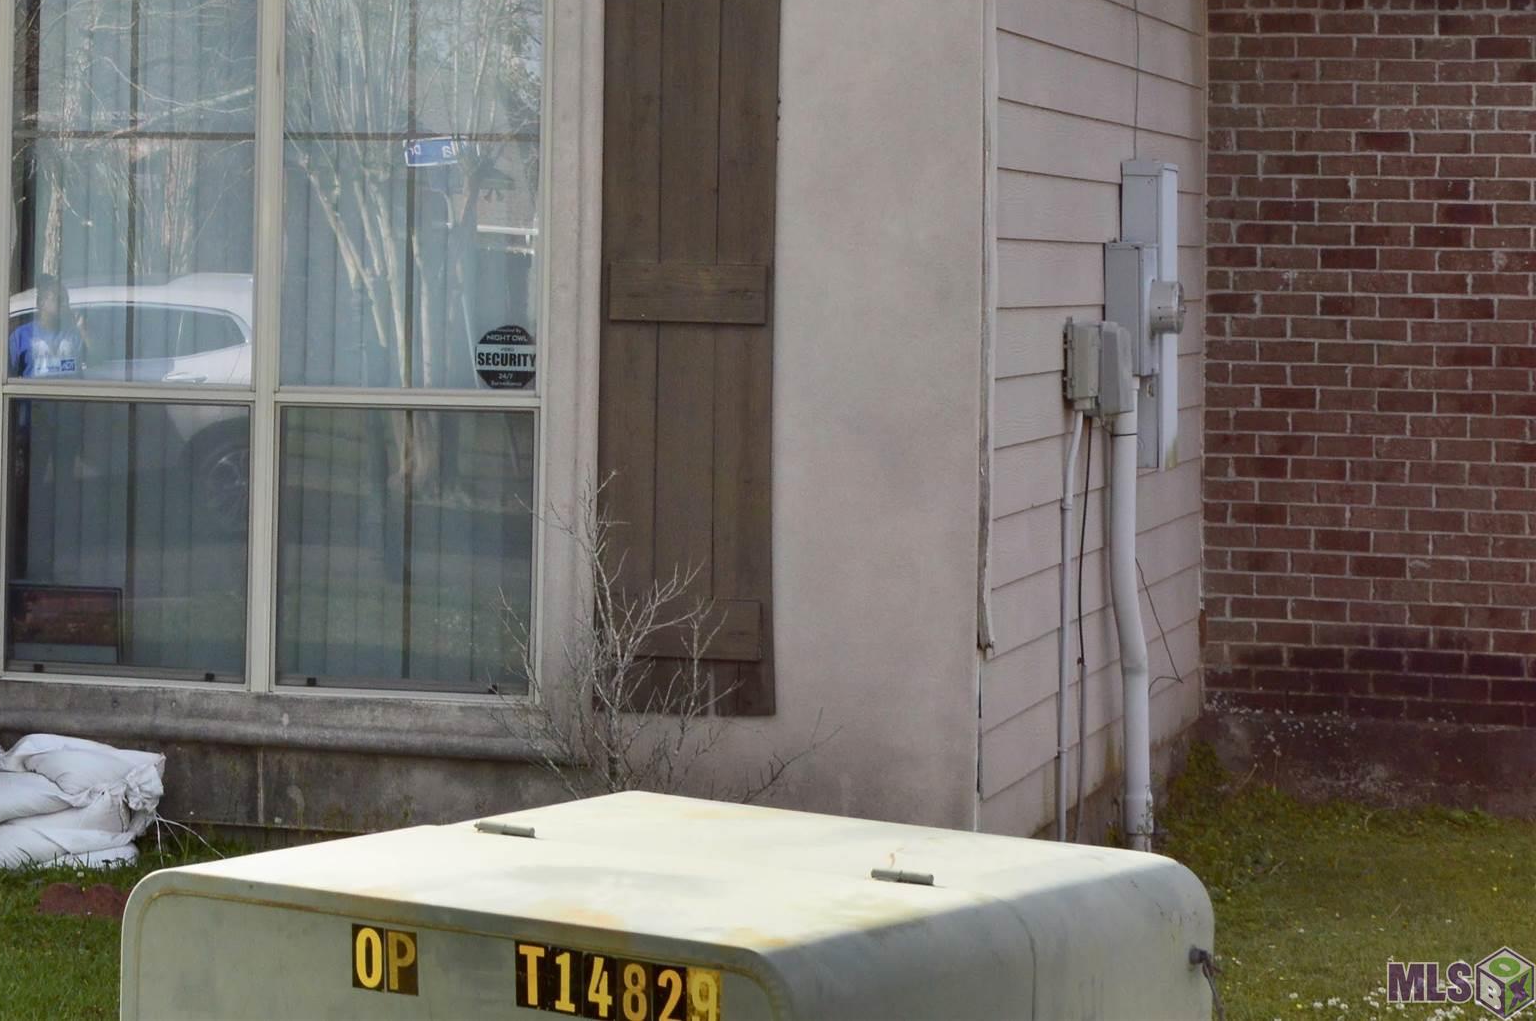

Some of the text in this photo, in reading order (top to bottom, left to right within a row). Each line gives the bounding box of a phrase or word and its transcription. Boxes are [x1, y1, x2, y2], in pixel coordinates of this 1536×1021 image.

[486, 334, 511, 342] NIGHT
[477, 352, 536, 367] SECURITY
[498, 372, 514, 380] 24/7
[518, 944, 718, 1021] T14829
